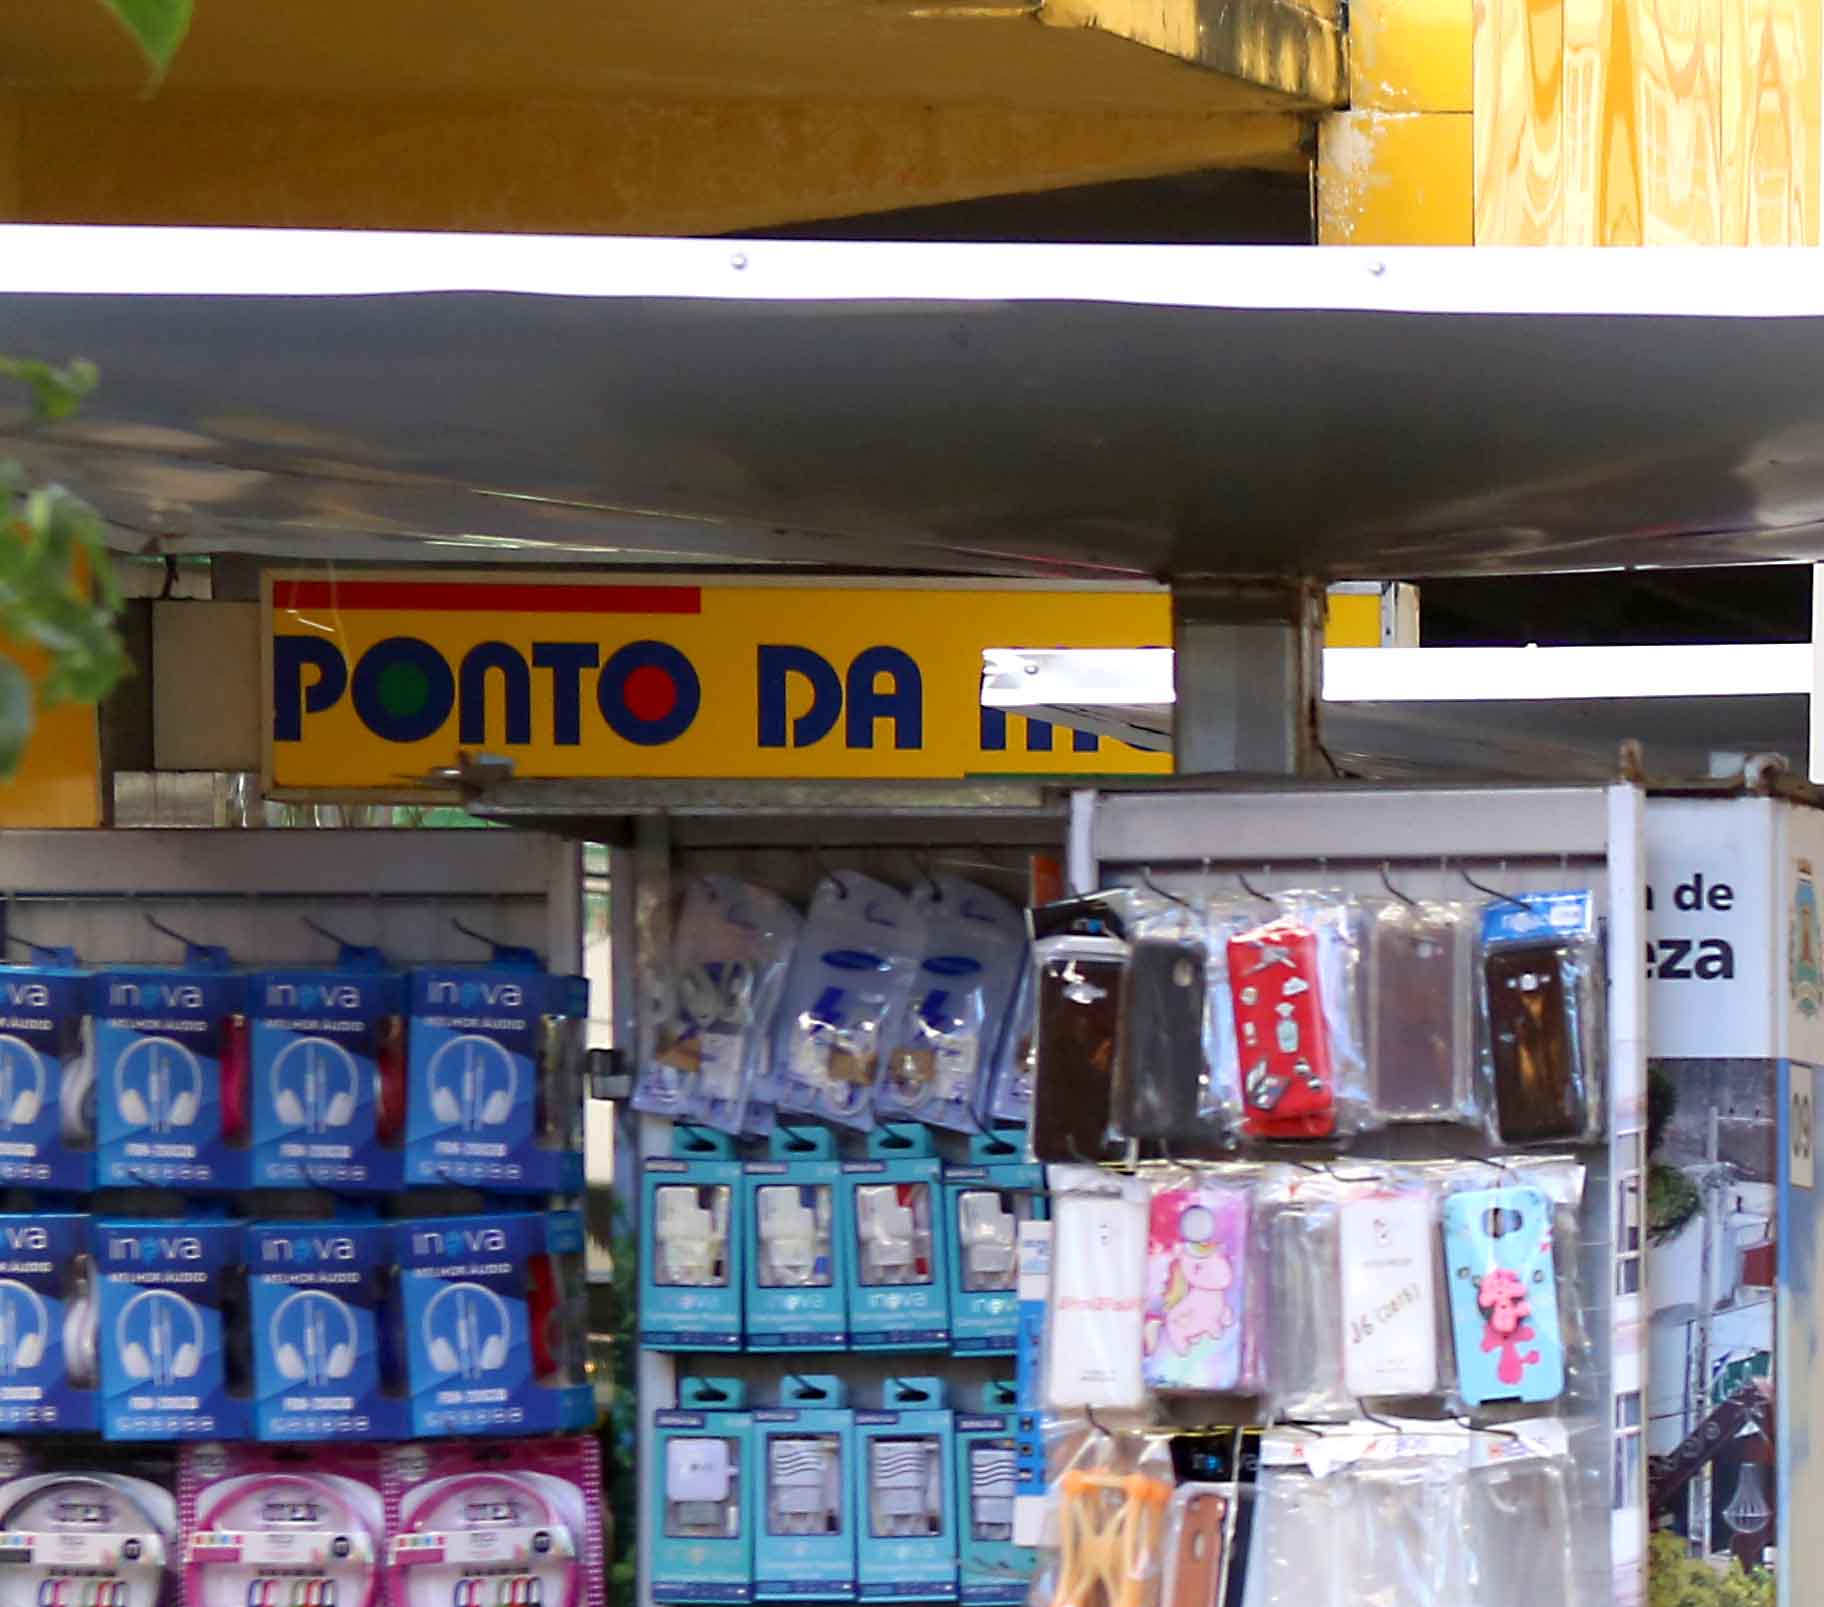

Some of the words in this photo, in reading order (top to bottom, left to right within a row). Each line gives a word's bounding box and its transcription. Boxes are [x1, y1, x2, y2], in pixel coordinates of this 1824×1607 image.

[757, 643, 923, 751] DA
[1673, 872, 1734, 912] de
[110, 980, 204, 1009] inova
[266, 981, 361, 1010] inova
[427, 976, 522, 1008] inova
[109, 1231, 203, 1260] inova
[262, 1232, 357, 1261] inova
[413, 1225, 507, 1256] inova
